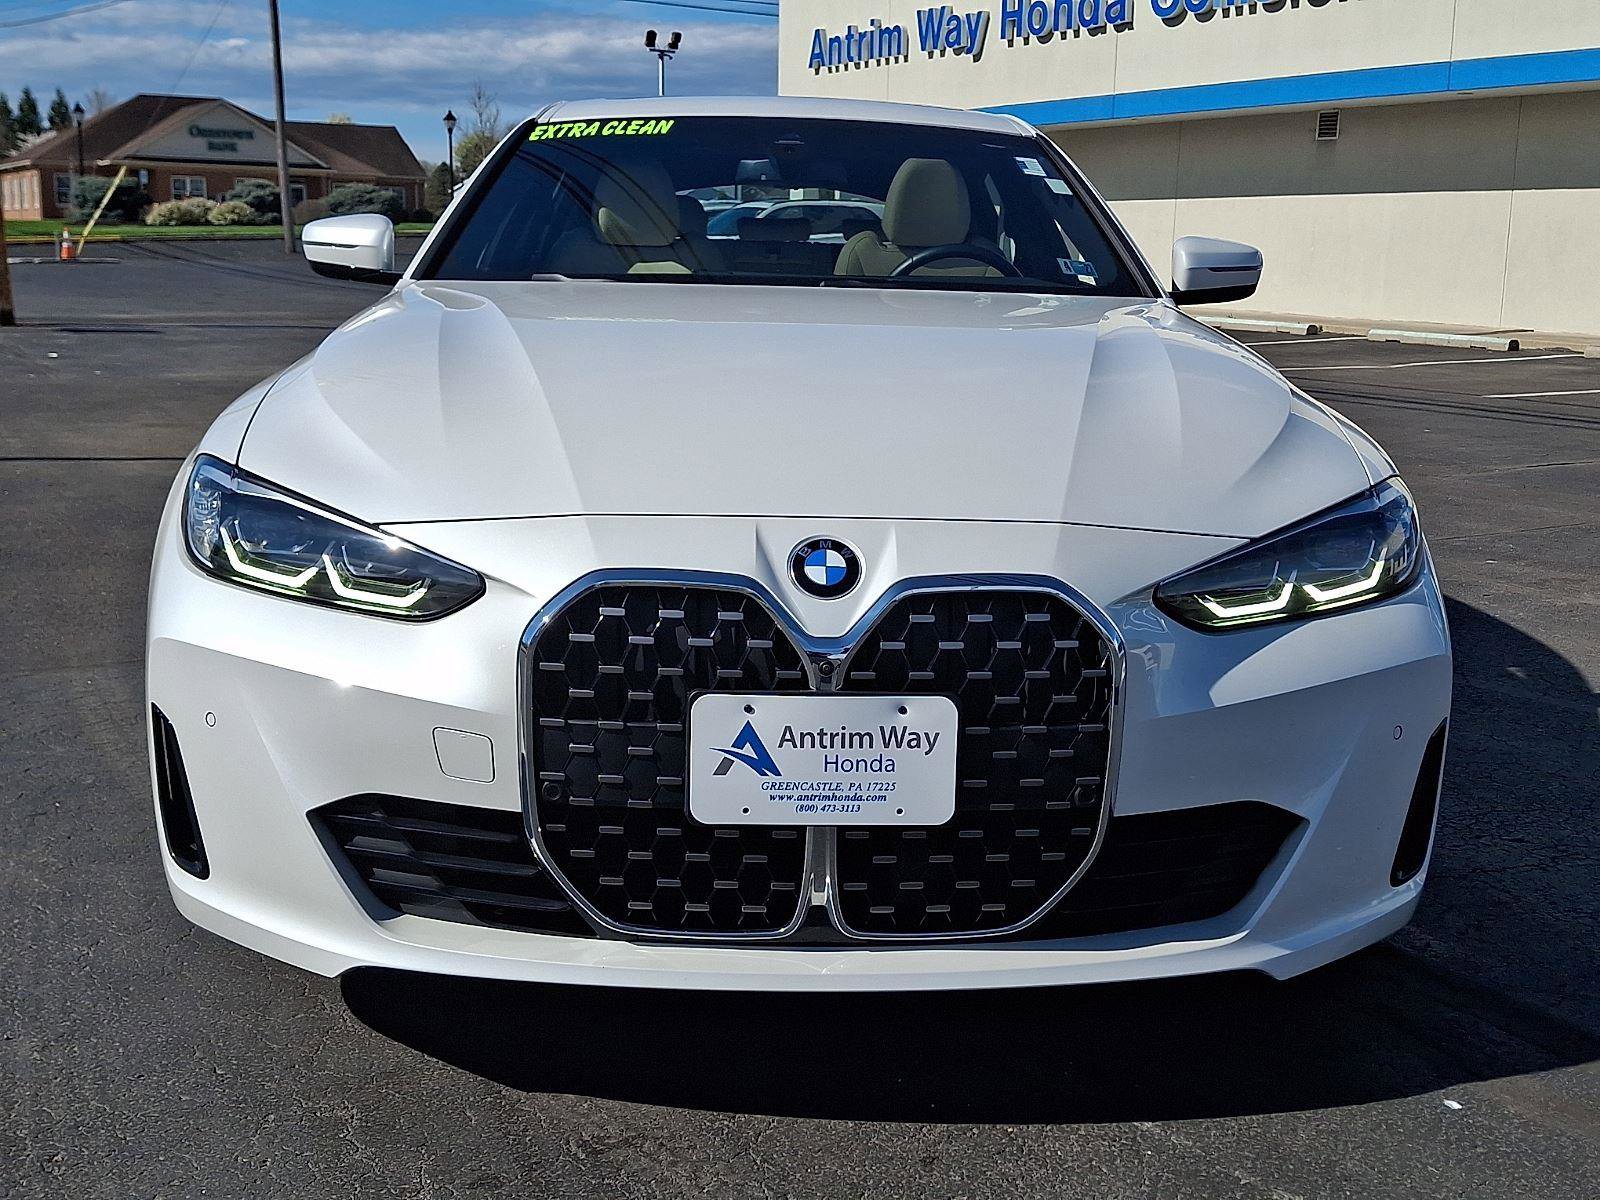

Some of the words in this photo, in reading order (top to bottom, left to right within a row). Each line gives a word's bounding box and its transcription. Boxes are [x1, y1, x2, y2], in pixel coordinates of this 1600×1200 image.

[808, 19, 908, 69] Antrim
[916, 6, 989, 55] Way
[1000, 0, 1133, 40] Honda
[529, 121, 600, 141] EXTRA
[601, 119, 674, 136] CLEAN
[798, 540, 854, 558] BMW
[777, 725, 874, 749] Antrim
[879, 725, 940, 756] Way
[824, 753, 896, 773] Honda
[761, 781, 844, 792] GREENCASTLE,
[848, 782, 863, 792] PA
[866, 782, 896, 792] 17225
[769, 792, 887, 802] www.antrimhonda.com
[795, 803, 819, 813] (800)
[820, 804, 861, 813] 473-3113
